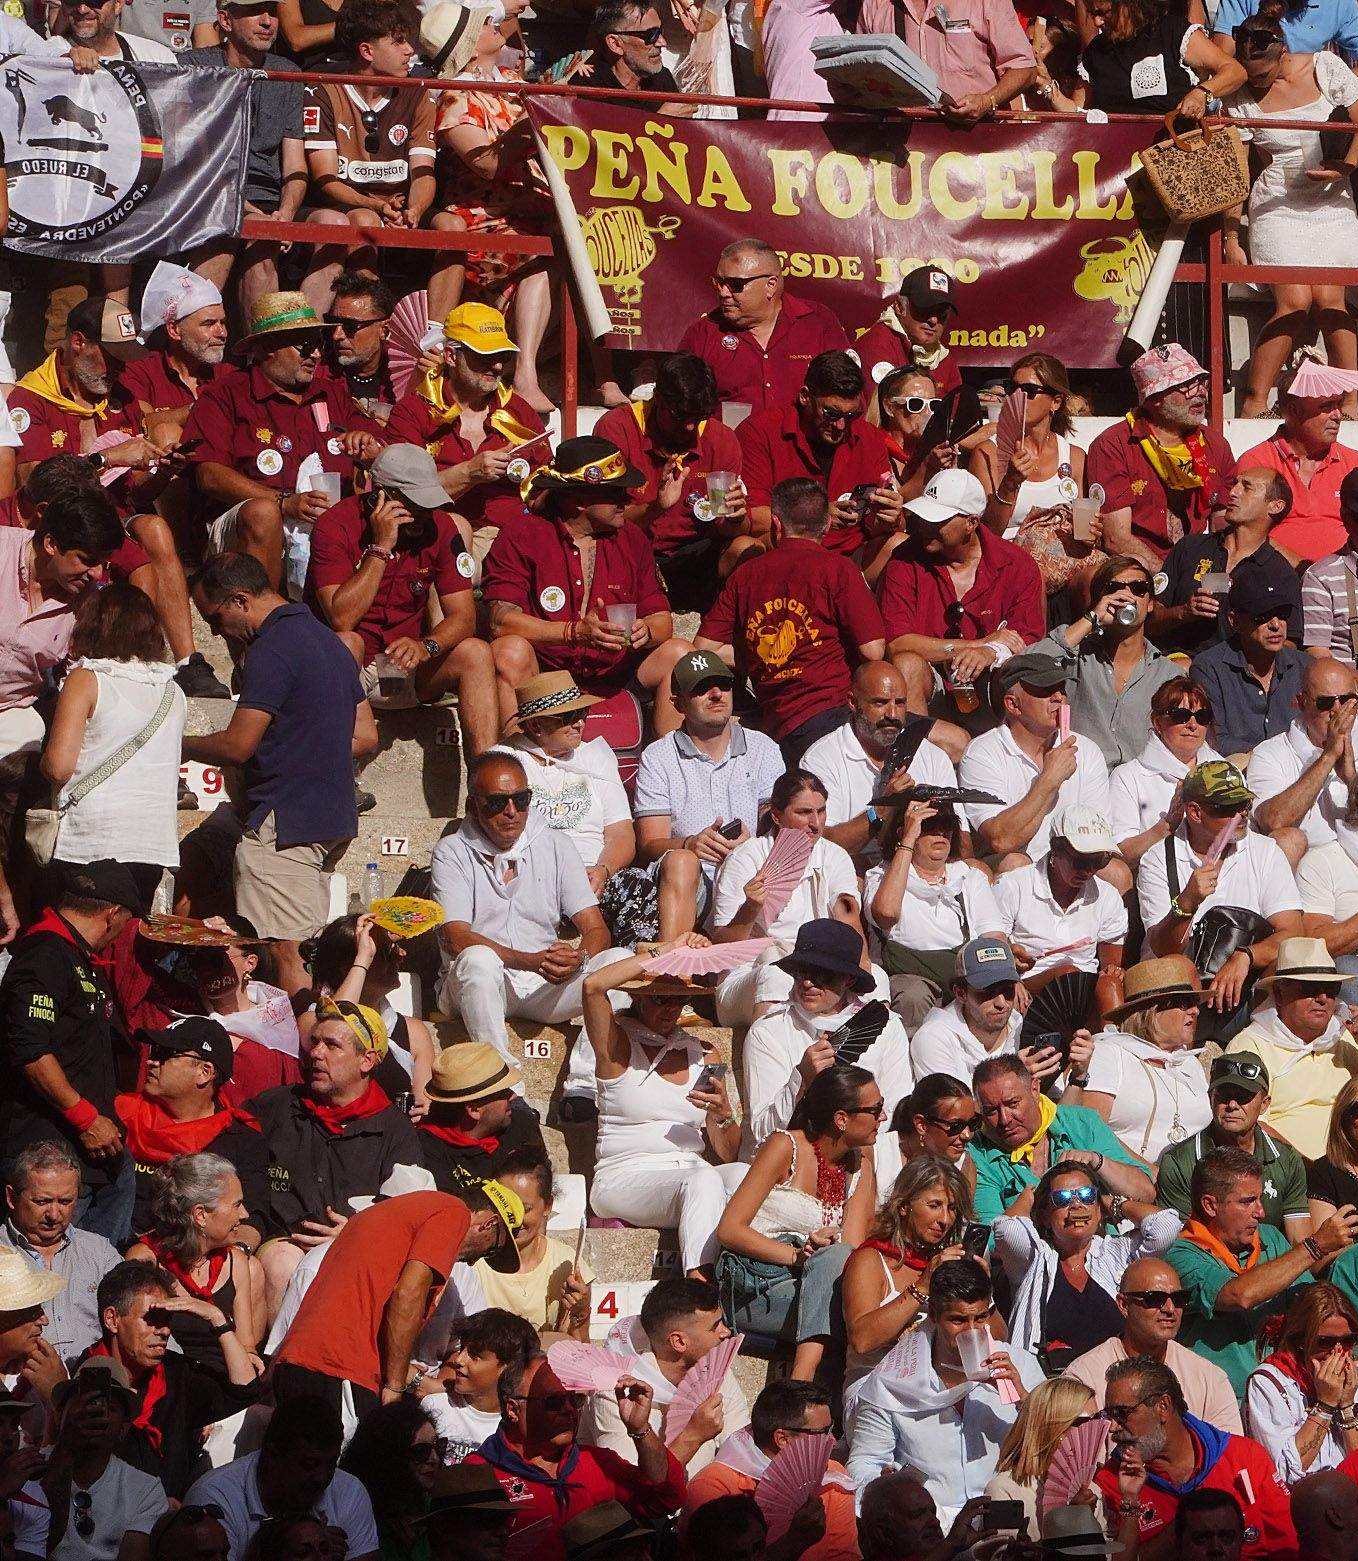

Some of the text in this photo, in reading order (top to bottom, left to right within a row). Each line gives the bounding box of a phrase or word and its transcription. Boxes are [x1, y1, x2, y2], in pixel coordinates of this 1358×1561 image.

[541, 121, 752, 213] PEÑA
[438, 730, 459, 744] 18
[202, 767, 223, 794] 9
[383, 838, 406, 854] 17
[33, 994, 54, 1009] PEÑA
[28, 1006, 55, 1022] FINOCA
[526, 1041, 549, 1057] 16
[597, 1291, 619, 1319] 4
